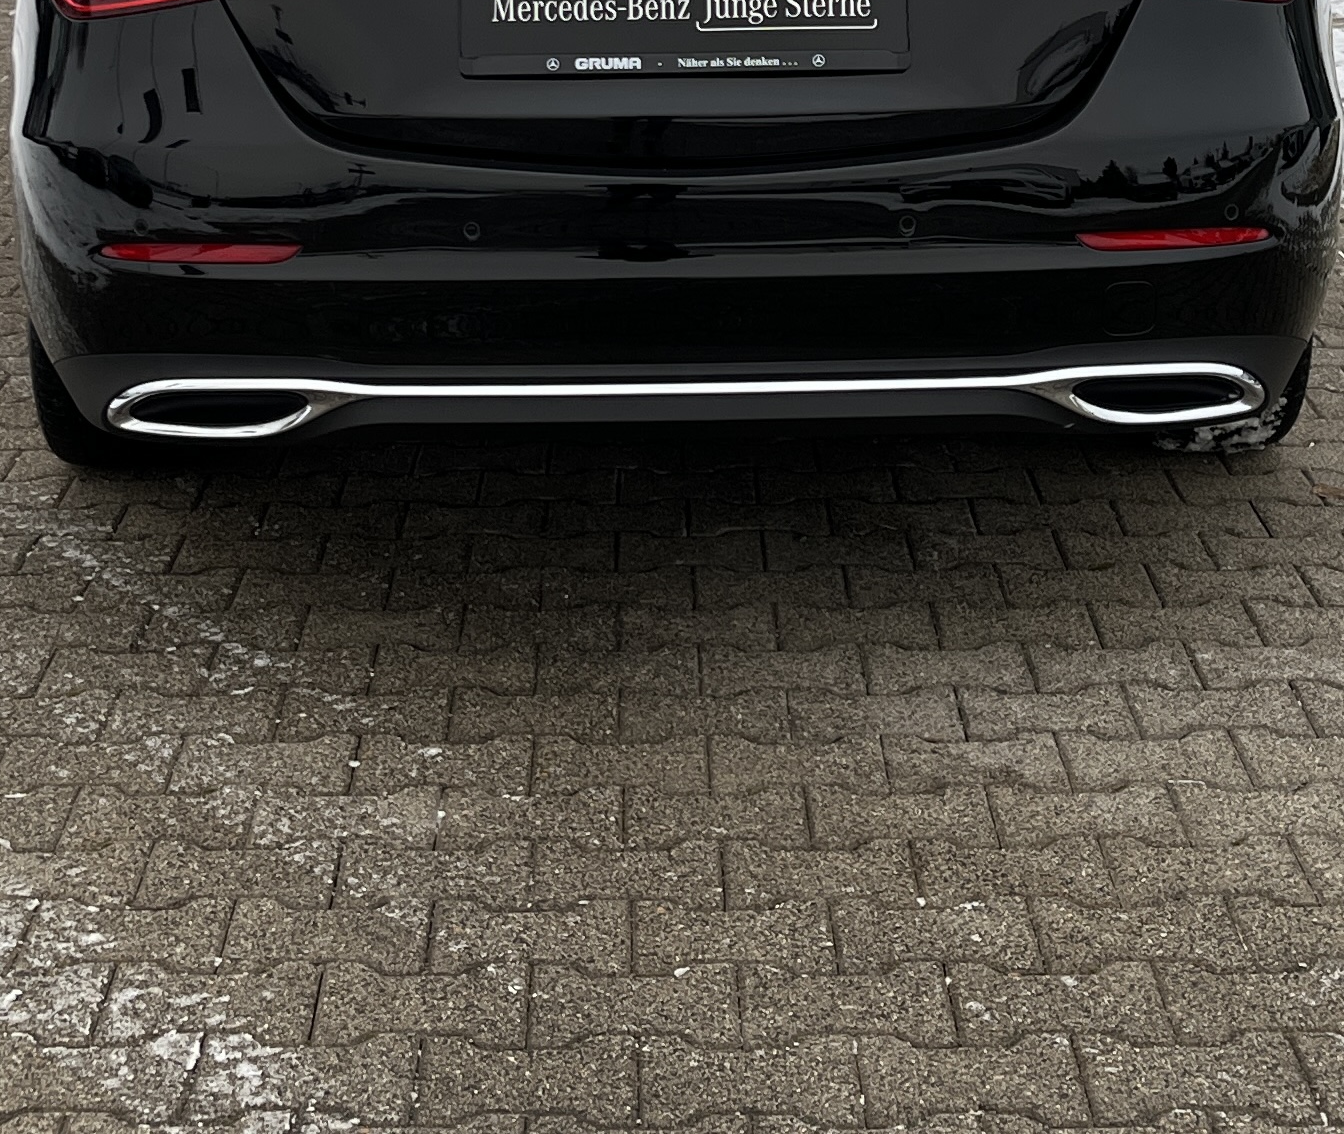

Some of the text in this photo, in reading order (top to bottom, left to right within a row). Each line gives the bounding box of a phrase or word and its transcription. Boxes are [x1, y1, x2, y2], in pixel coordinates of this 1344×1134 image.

[574, 56, 642, 70] GRUMA
[677, 57, 708, 68] Näher
[710, 57, 725, 67] als
[726, 56, 743, 67] Sie
[744, 56, 780, 67] denken
